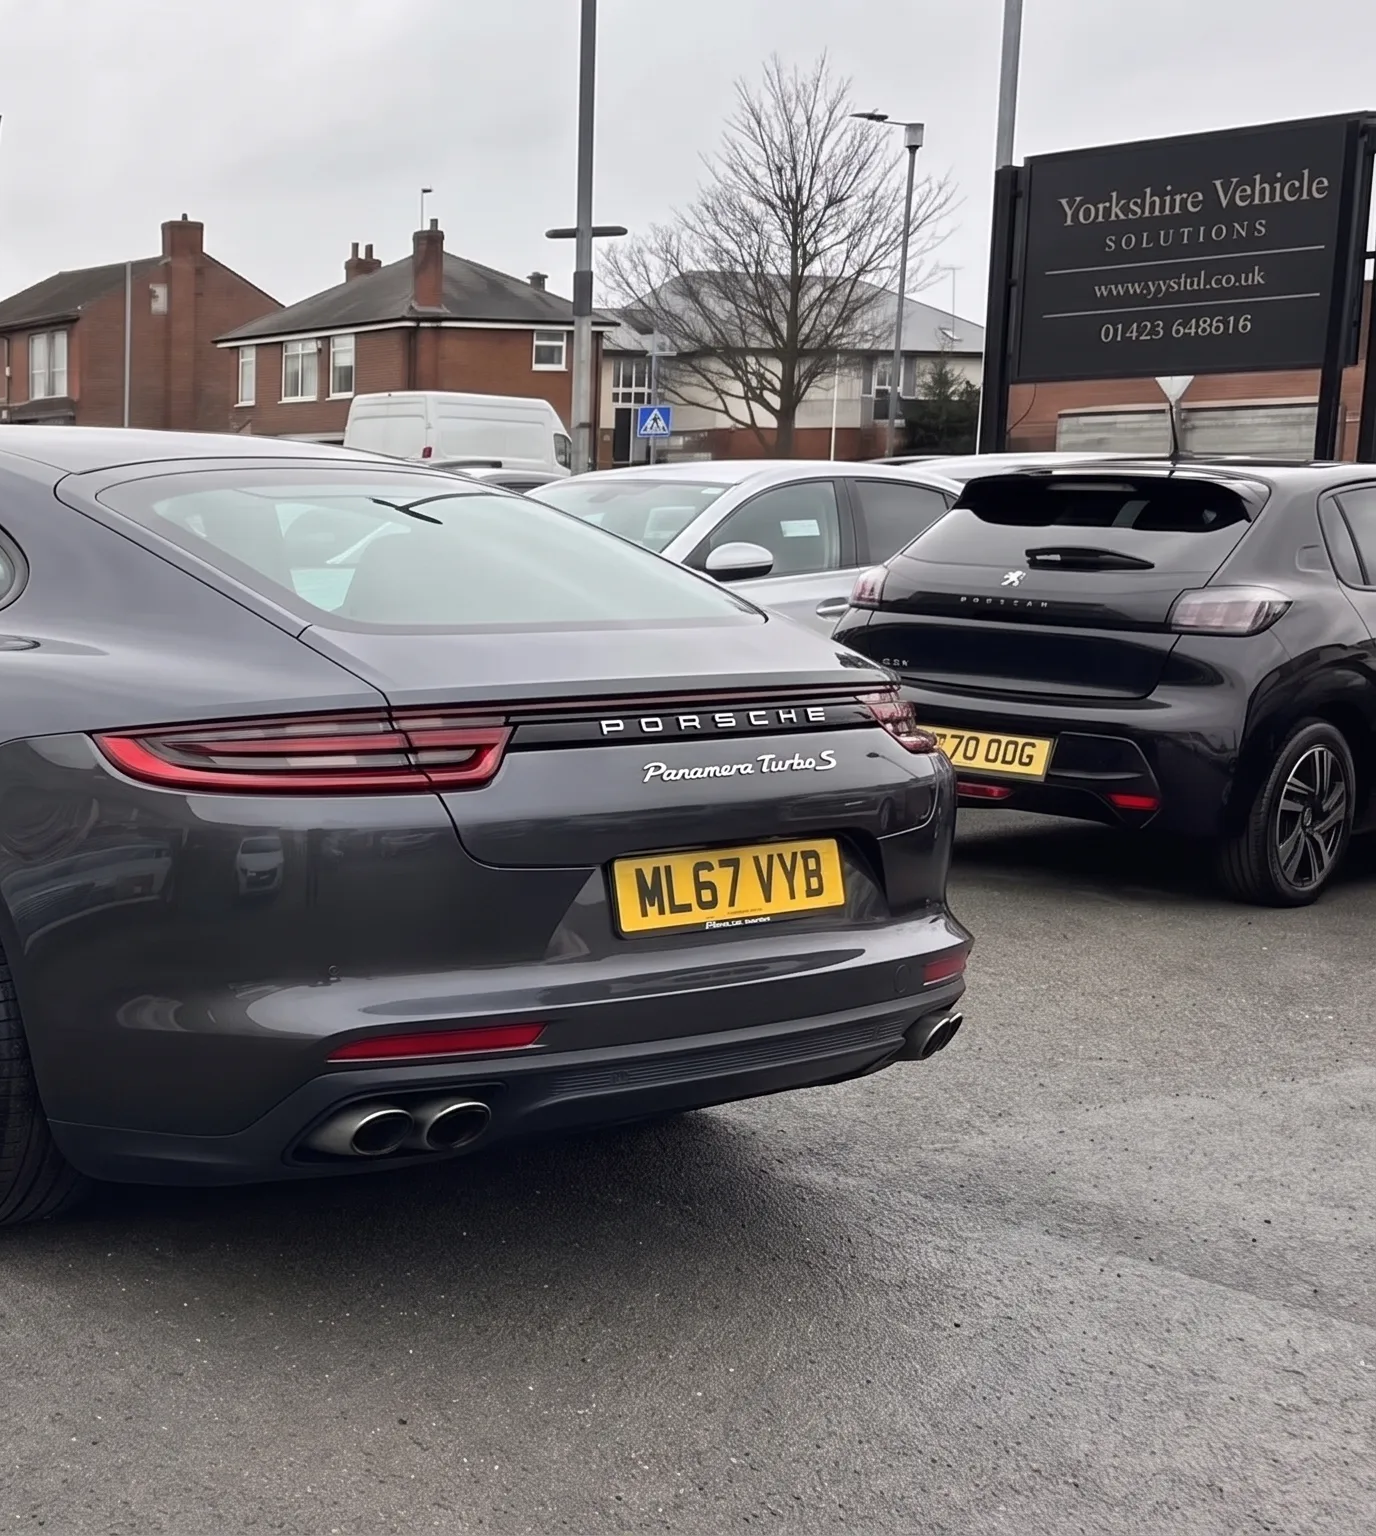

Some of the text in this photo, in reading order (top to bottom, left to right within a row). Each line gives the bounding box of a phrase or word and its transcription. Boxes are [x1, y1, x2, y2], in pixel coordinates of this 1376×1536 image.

[1058, 169, 1330, 226] Yorkshire Vehicle
[1105, 219, 1267, 252] SOLUTIONS
[1100, 313, 1253, 343] 01423 648616
[600, 706, 826, 734] PORSCHE
[643, 750, 837, 783] Panamera Turbo S
[634, 849, 824, 918] ML67 VYB
